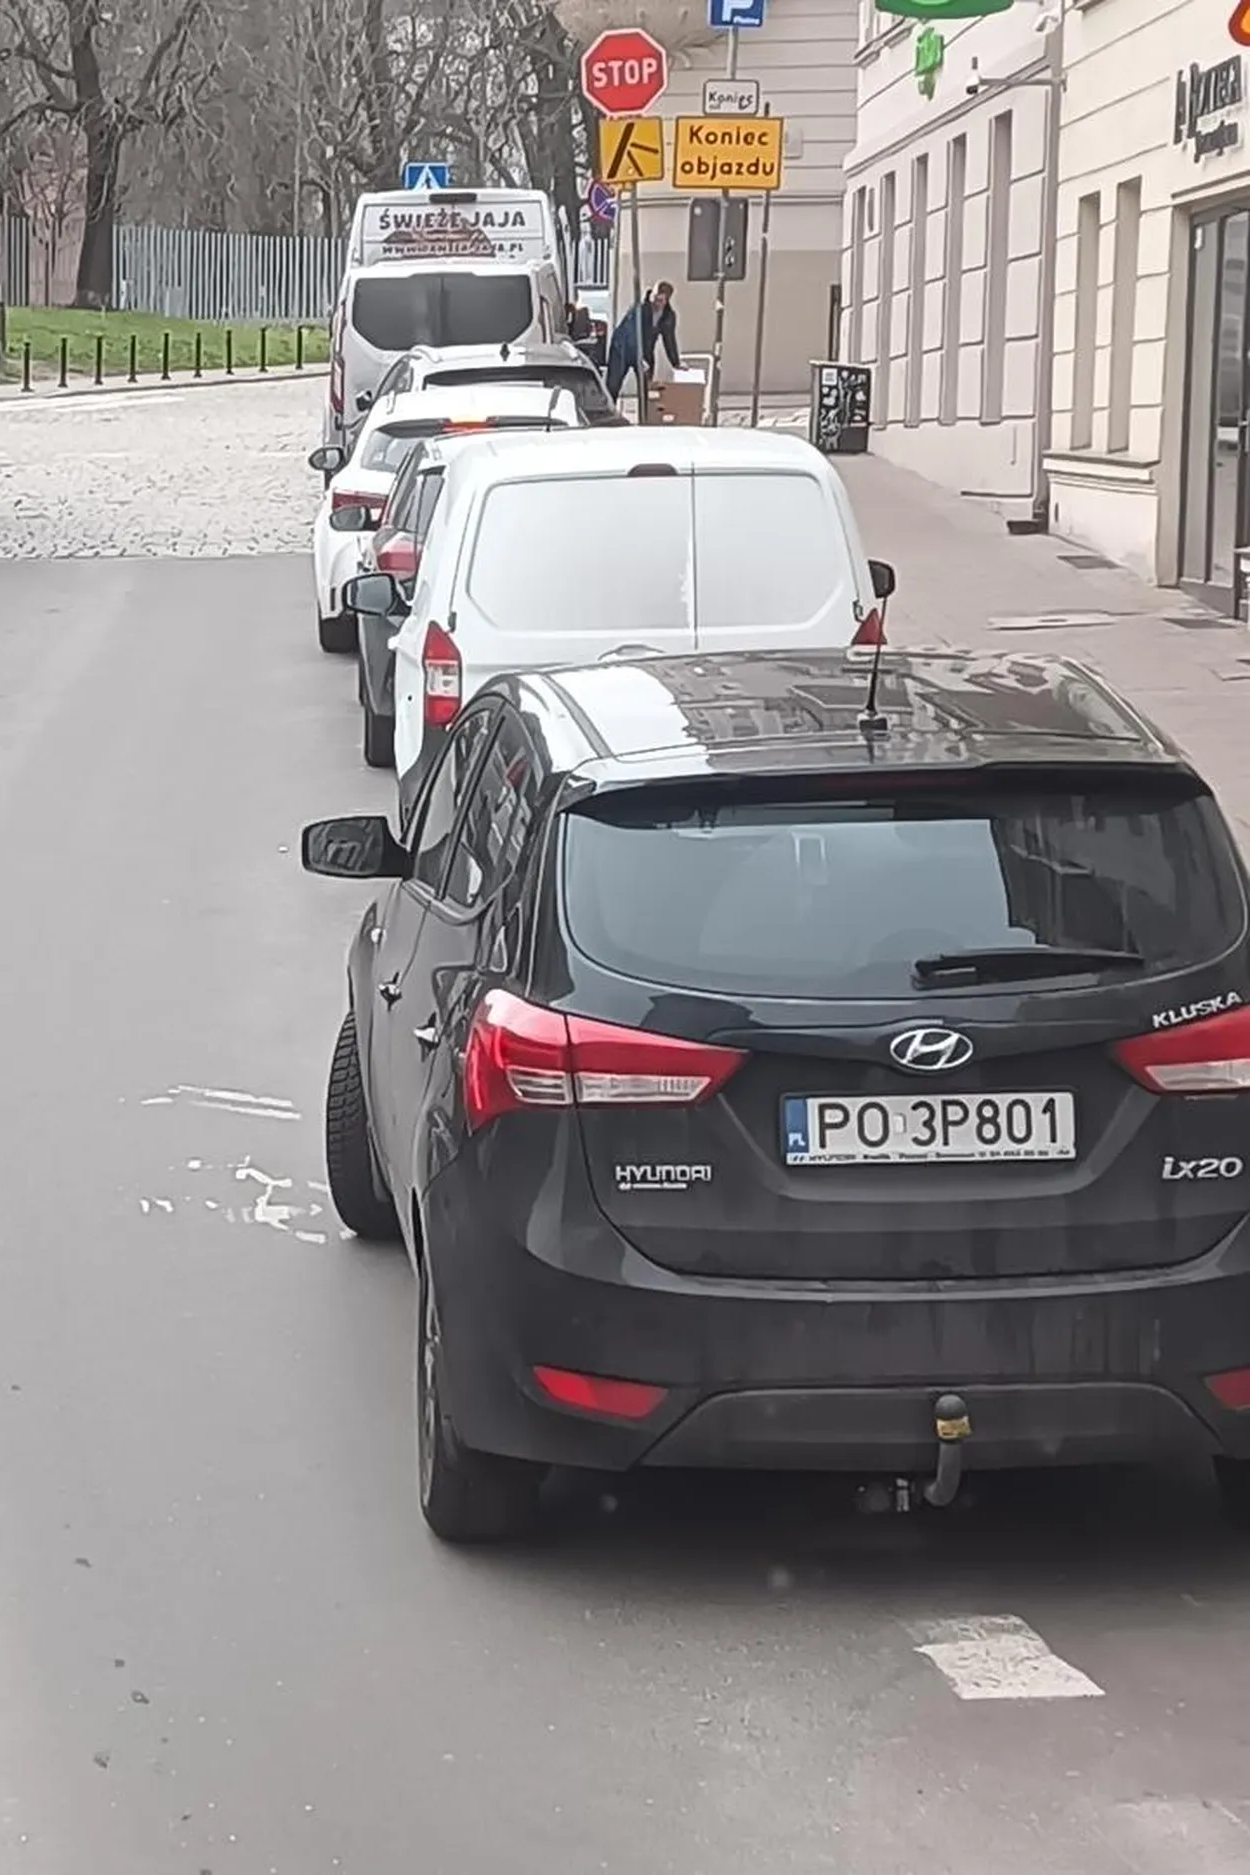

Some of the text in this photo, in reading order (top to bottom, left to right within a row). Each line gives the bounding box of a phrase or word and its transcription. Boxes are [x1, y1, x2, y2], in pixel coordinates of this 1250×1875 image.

[591, 57, 658, 88] STOP
[689, 124, 769, 146] Koniec
[680, 156, 776, 181] objazdu
[379, 208, 526, 230] ŚWIEŻE JAJA
[1152, 991, 1243, 1028] KLUSKA
[817, 1097, 1058, 1149] PO 3P801
[788, 1132, 806, 1146] PL
[615, 1165, 712, 1181] HYUNDAI
[1162, 1156, 1243, 1179] ix20
